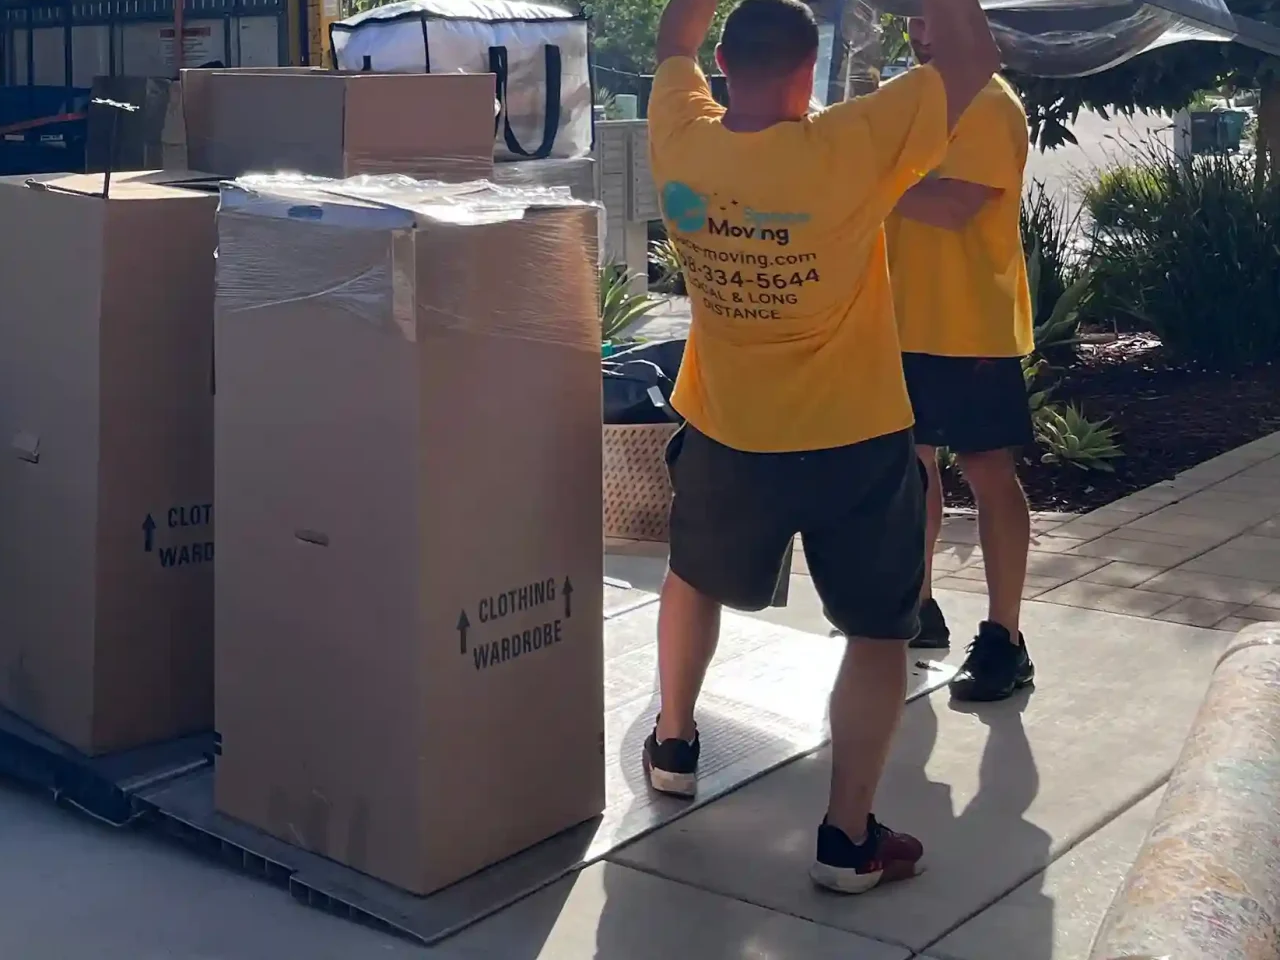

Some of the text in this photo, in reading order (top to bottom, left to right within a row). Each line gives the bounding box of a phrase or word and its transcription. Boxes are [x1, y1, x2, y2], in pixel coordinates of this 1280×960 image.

[703, 297, 781, 320] DISTANCE
[731, 291, 744, 303] &
[748, 292, 798, 305] LONG
[167, 503, 213, 528] CLOT
[478, 577, 556, 623] CLOTHING
[473, 619, 563, 671] WARDROBE
